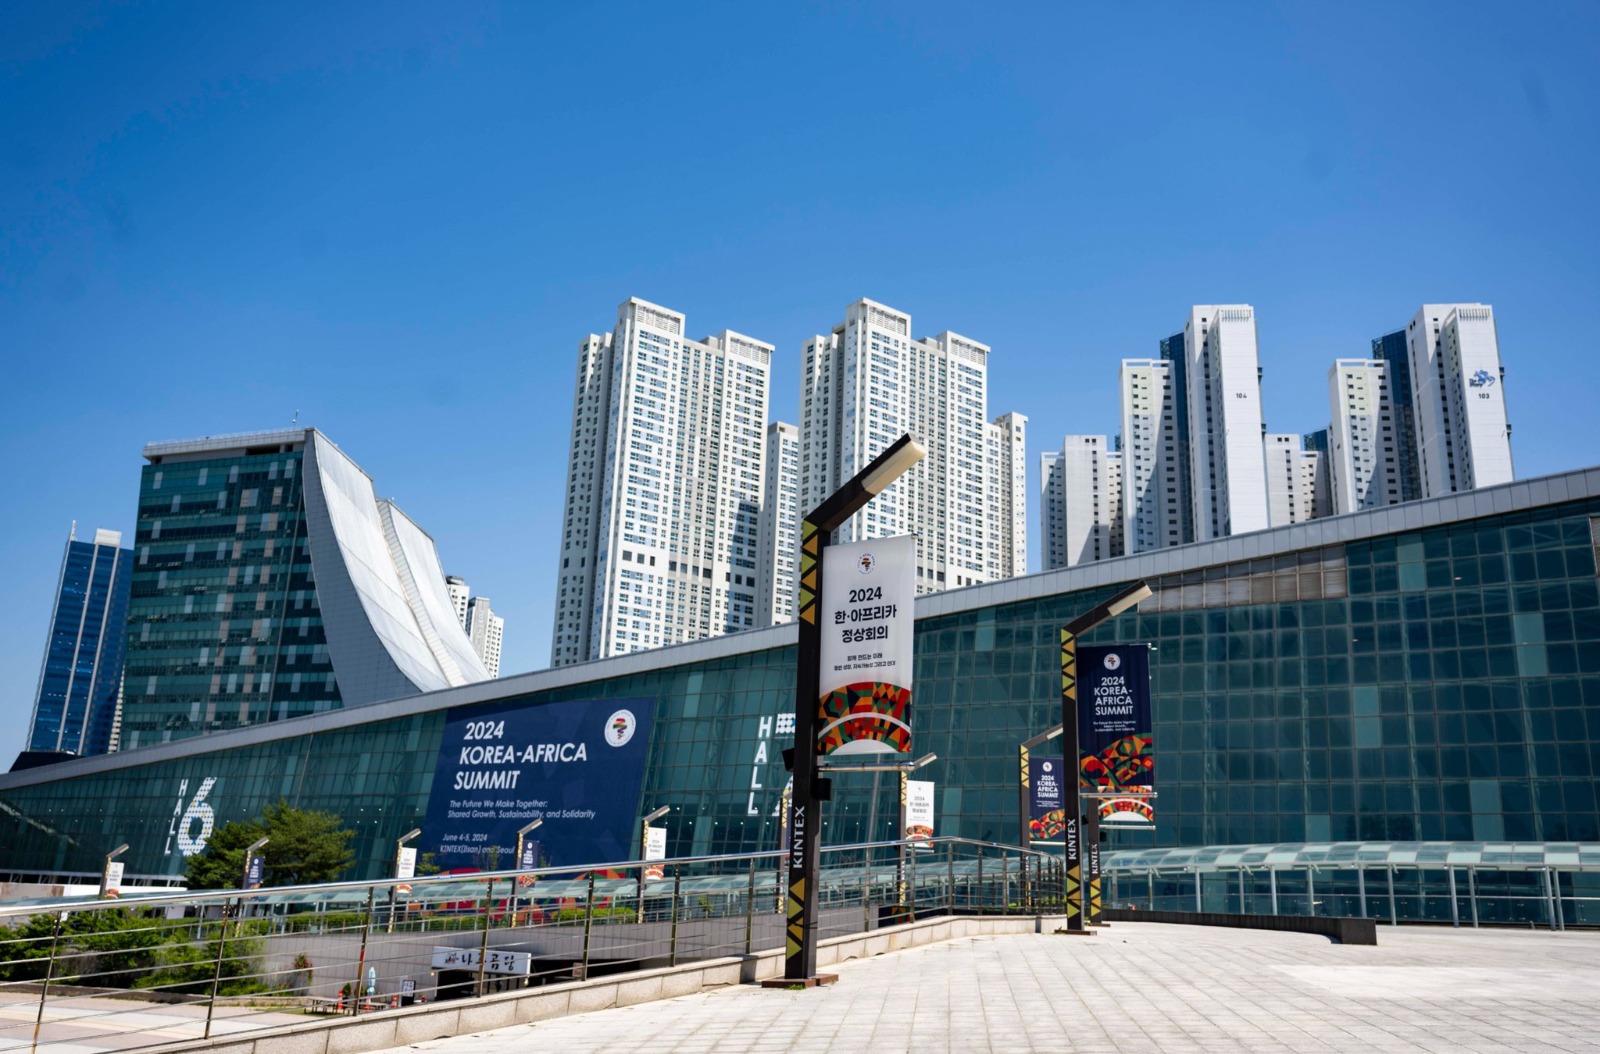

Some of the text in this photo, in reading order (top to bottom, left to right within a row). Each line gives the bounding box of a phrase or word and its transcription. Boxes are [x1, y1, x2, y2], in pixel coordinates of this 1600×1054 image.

[849, 586, 882, 603] 2024
[834, 604, 897, 625] 한·아프리카
[842, 625, 888, 643] 정상회의
[1101, 676, 1125, 686] 2024
[1094, 686, 1133, 696] KOREA-
[1095, 695, 1133, 705] AFRICA
[1095, 705, 1133, 715] SUMMIT
[464, 721, 505, 740] 2024
[459, 742, 588, 765] KOREA-AFRICA
[454, 770, 520, 790] SUMMIT
[450, 799, 548, 810] The Future We Make Together:
[177, 776, 217, 857] 6
[447, 810, 596, 819] Shared Growth, Sustainability, and Solidarity
[442, 833, 488, 842] June 4-5, 2024
[793, 805, 805, 869] KINTEX
[1068, 819, 1077, 860] KINTEX
